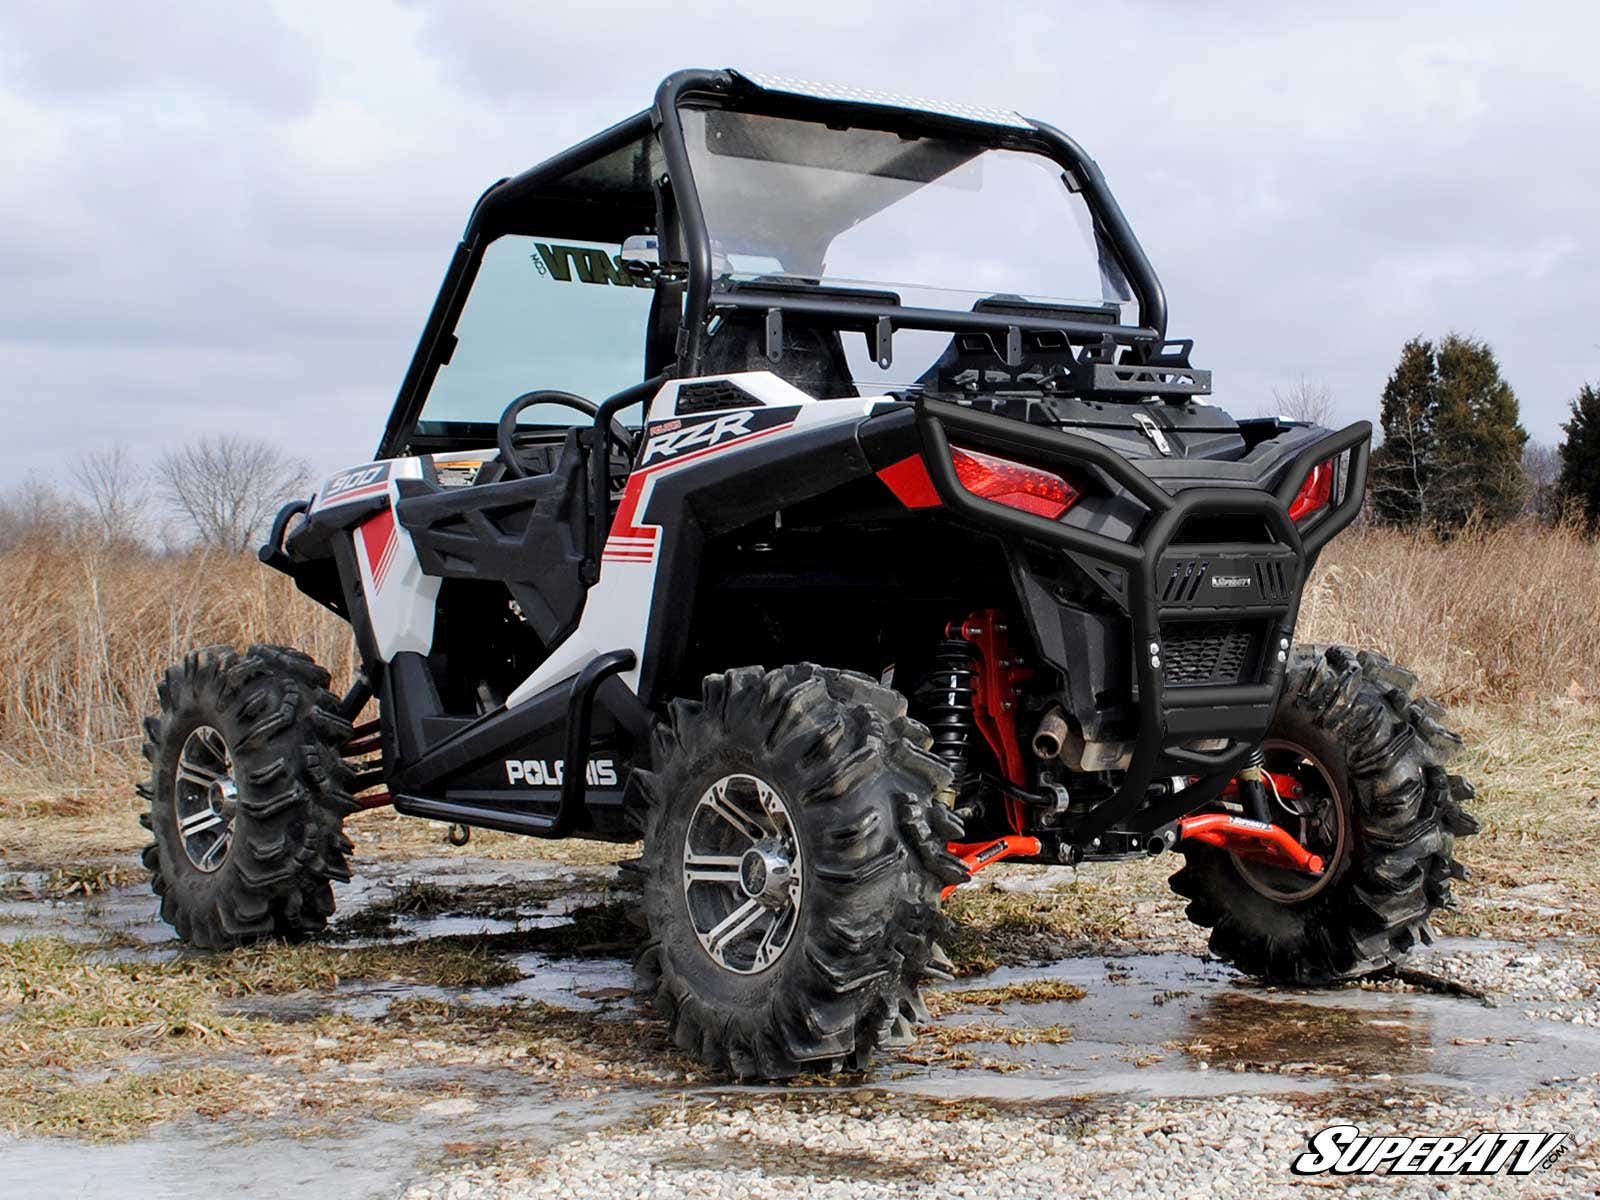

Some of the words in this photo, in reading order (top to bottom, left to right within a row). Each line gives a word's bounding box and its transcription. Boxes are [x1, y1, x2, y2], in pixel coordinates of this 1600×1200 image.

[641, 410, 755, 466] RZR
[327, 465, 385, 496] 900
[505, 759, 618, 785] POLIS
